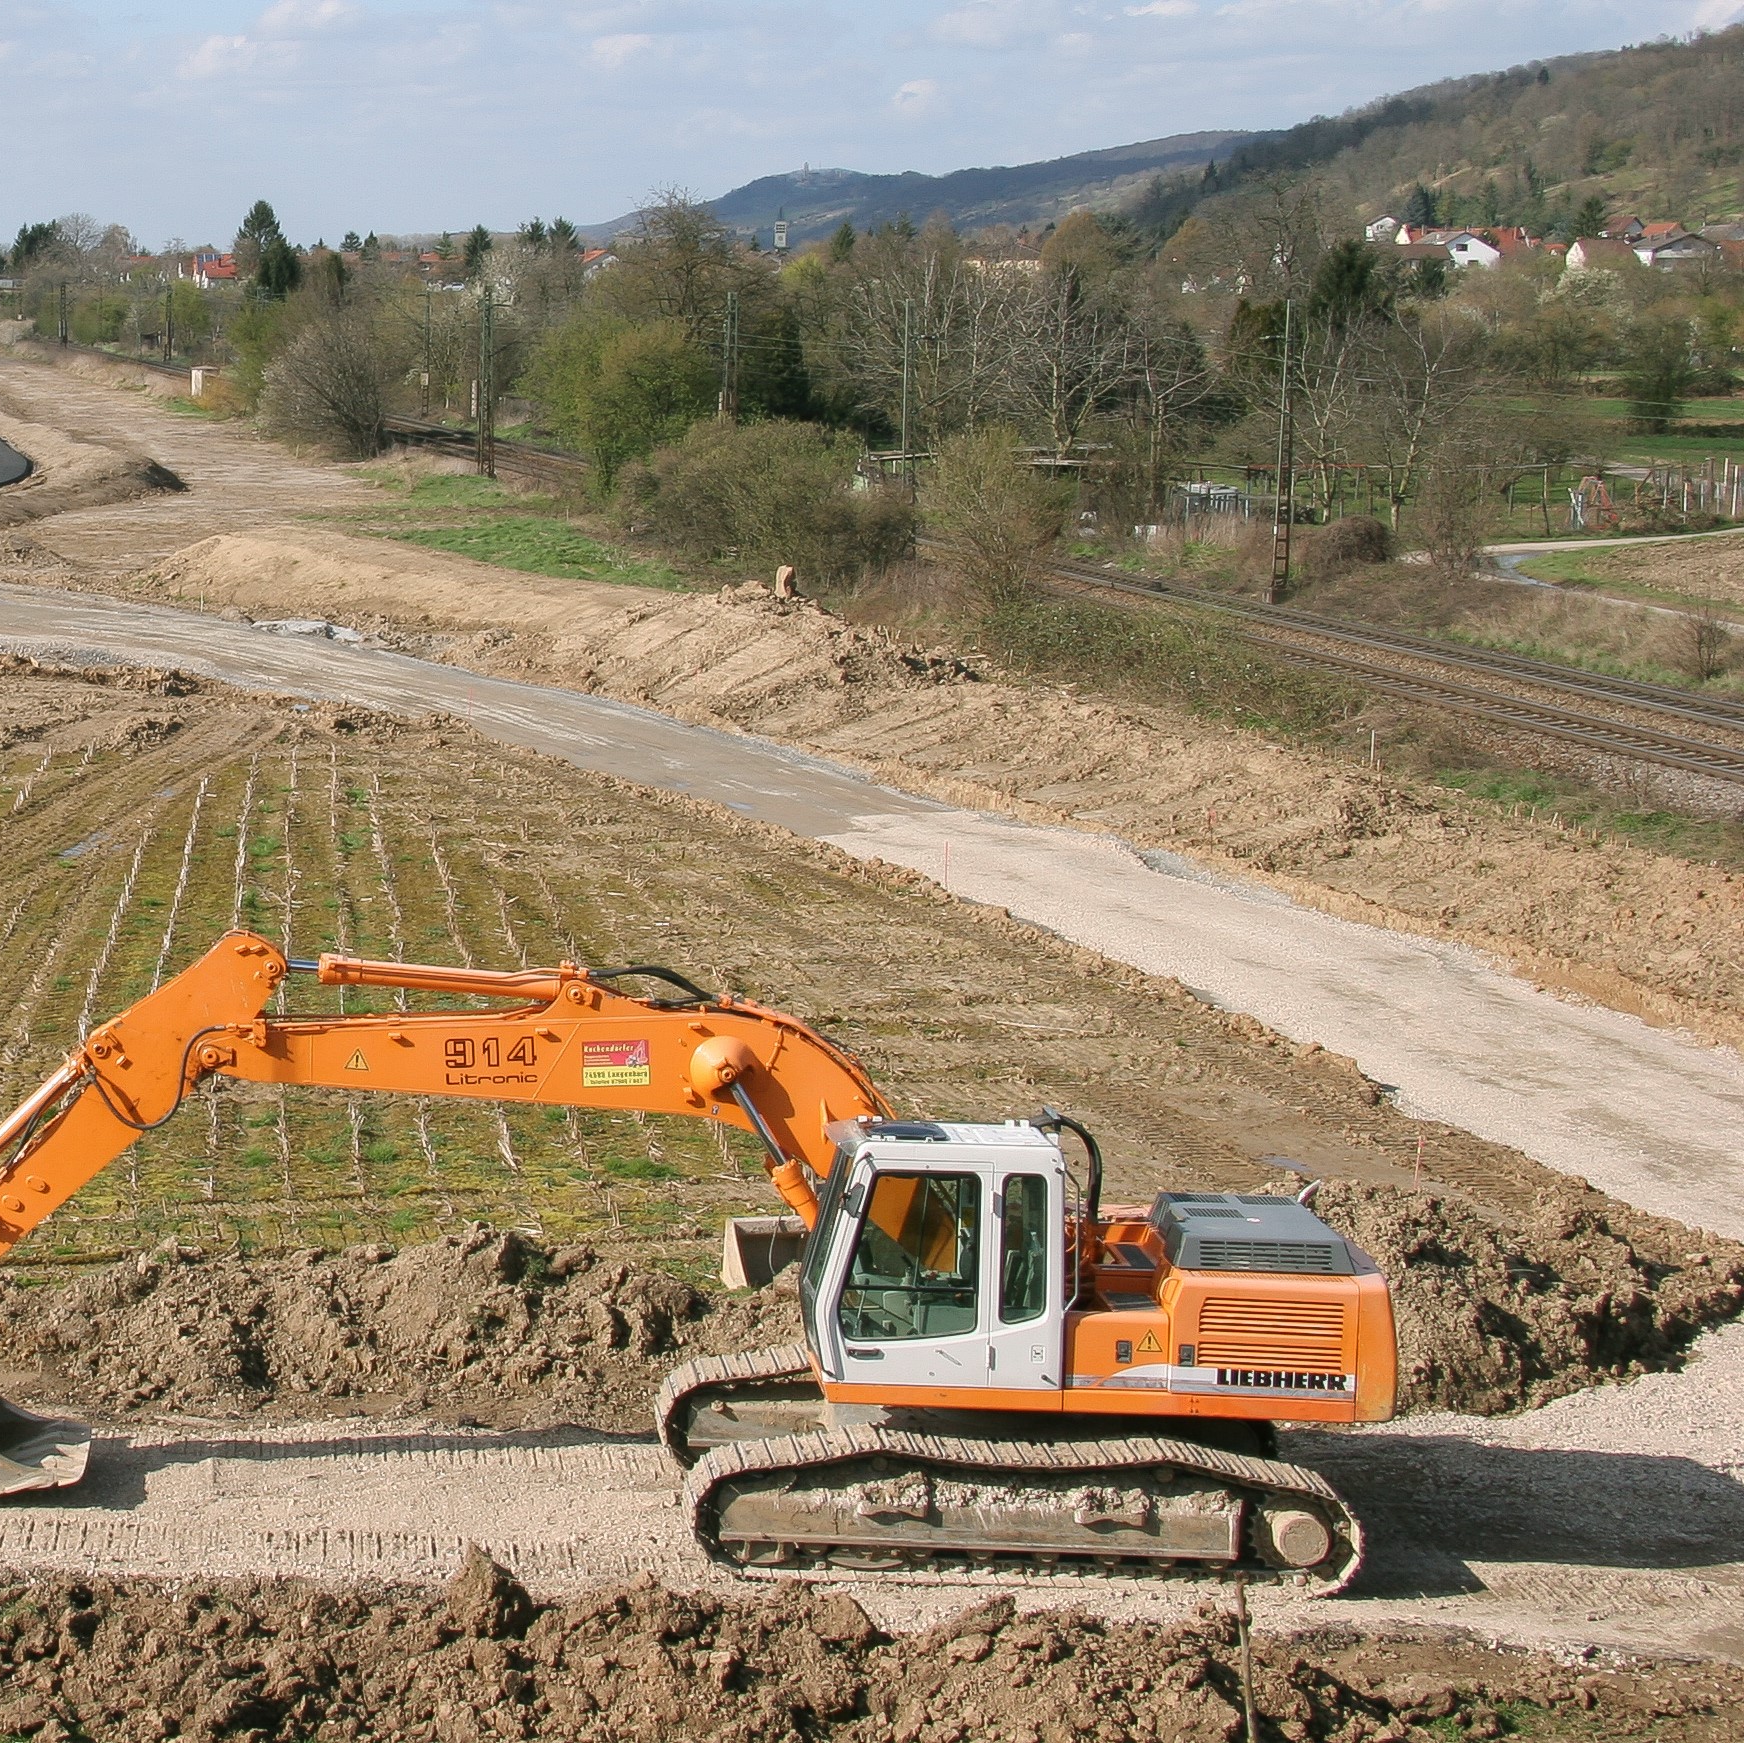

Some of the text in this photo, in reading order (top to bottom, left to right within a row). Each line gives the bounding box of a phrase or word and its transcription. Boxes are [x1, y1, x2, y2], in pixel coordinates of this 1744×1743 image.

[445, 1036, 538, 1068] 914
[445, 1071, 538, 1085] Litronic
[1216, 1368, 1347, 1391] LIEBHERR
